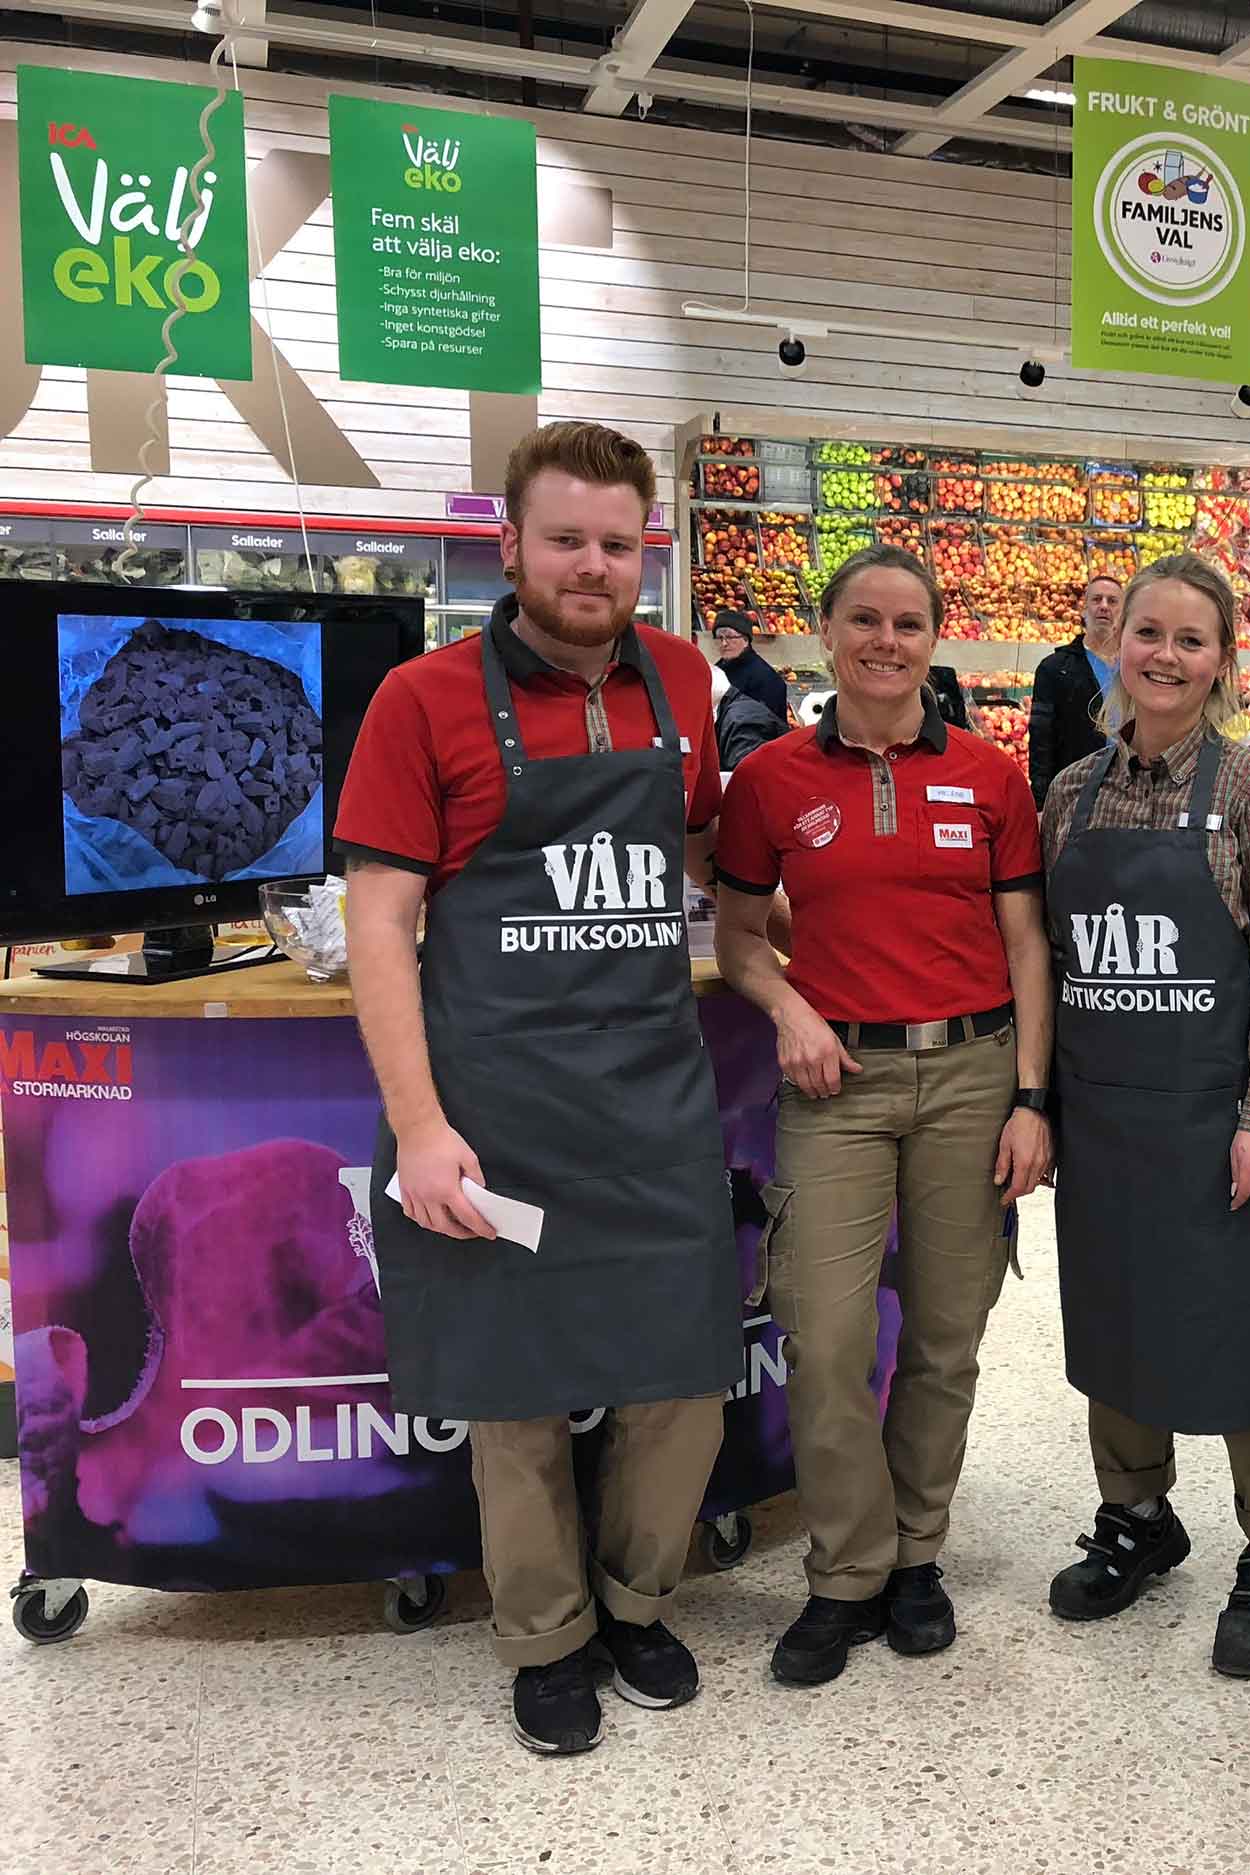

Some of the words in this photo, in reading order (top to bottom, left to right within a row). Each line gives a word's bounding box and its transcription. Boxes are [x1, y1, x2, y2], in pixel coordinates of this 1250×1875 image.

[1087, 90, 1157, 118] FRUKT
[1163, 100, 1177, 121] &
[1182, 104, 1250, 135] GRÖNT
[48, 121, 97, 151] ICA
[402, 132, 462, 171] Välj
[404, 164, 463, 193] eko
[49, 152, 218, 253] Välj
[1120, 200, 1224, 233] FAMILJENS
[371, 207, 415, 231] Fem
[420, 212, 460, 235] skäl
[372, 235, 402, 255] att
[406, 238, 453, 263] välja
[458, 241, 501, 265] eko:
[1155, 226, 1194, 250] VAL
[53, 236, 221, 313] eko
[405, 267, 423, 281] för
[425, 270, 461, 285] miljön
[429, 286, 496, 308] djurhållning
[411, 304, 469, 322] syntetiska
[471, 310, 501, 323] gifter
[1101, 311, 1138, 328] Alltid
[1140, 315, 1160, 330] ett
[1160, 319, 1207, 336] perfekt
[416, 320, 487, 339] konstgödsel
[421, 338, 436, 353] på
[438, 341, 484, 357] resurser
[231, 534, 284, 549] Sallader
[355, 539, 405, 555] Sallader
[938, 828, 968, 839] MAXI
[542, 830, 667, 911] VÅR
[205, 894, 217, 904] LG
[1069, 902, 1180, 976] VÅR
[1061, 984, 1215, 1014] BUTIKSODLING
[65, 1031, 131, 1043] HÖGSKOLAN
[0, 1029, 133, 1085] MAXI
[12, 1080, 133, 1101] STORMARKNAD
[180, 1400, 470, 1466] ODLING
